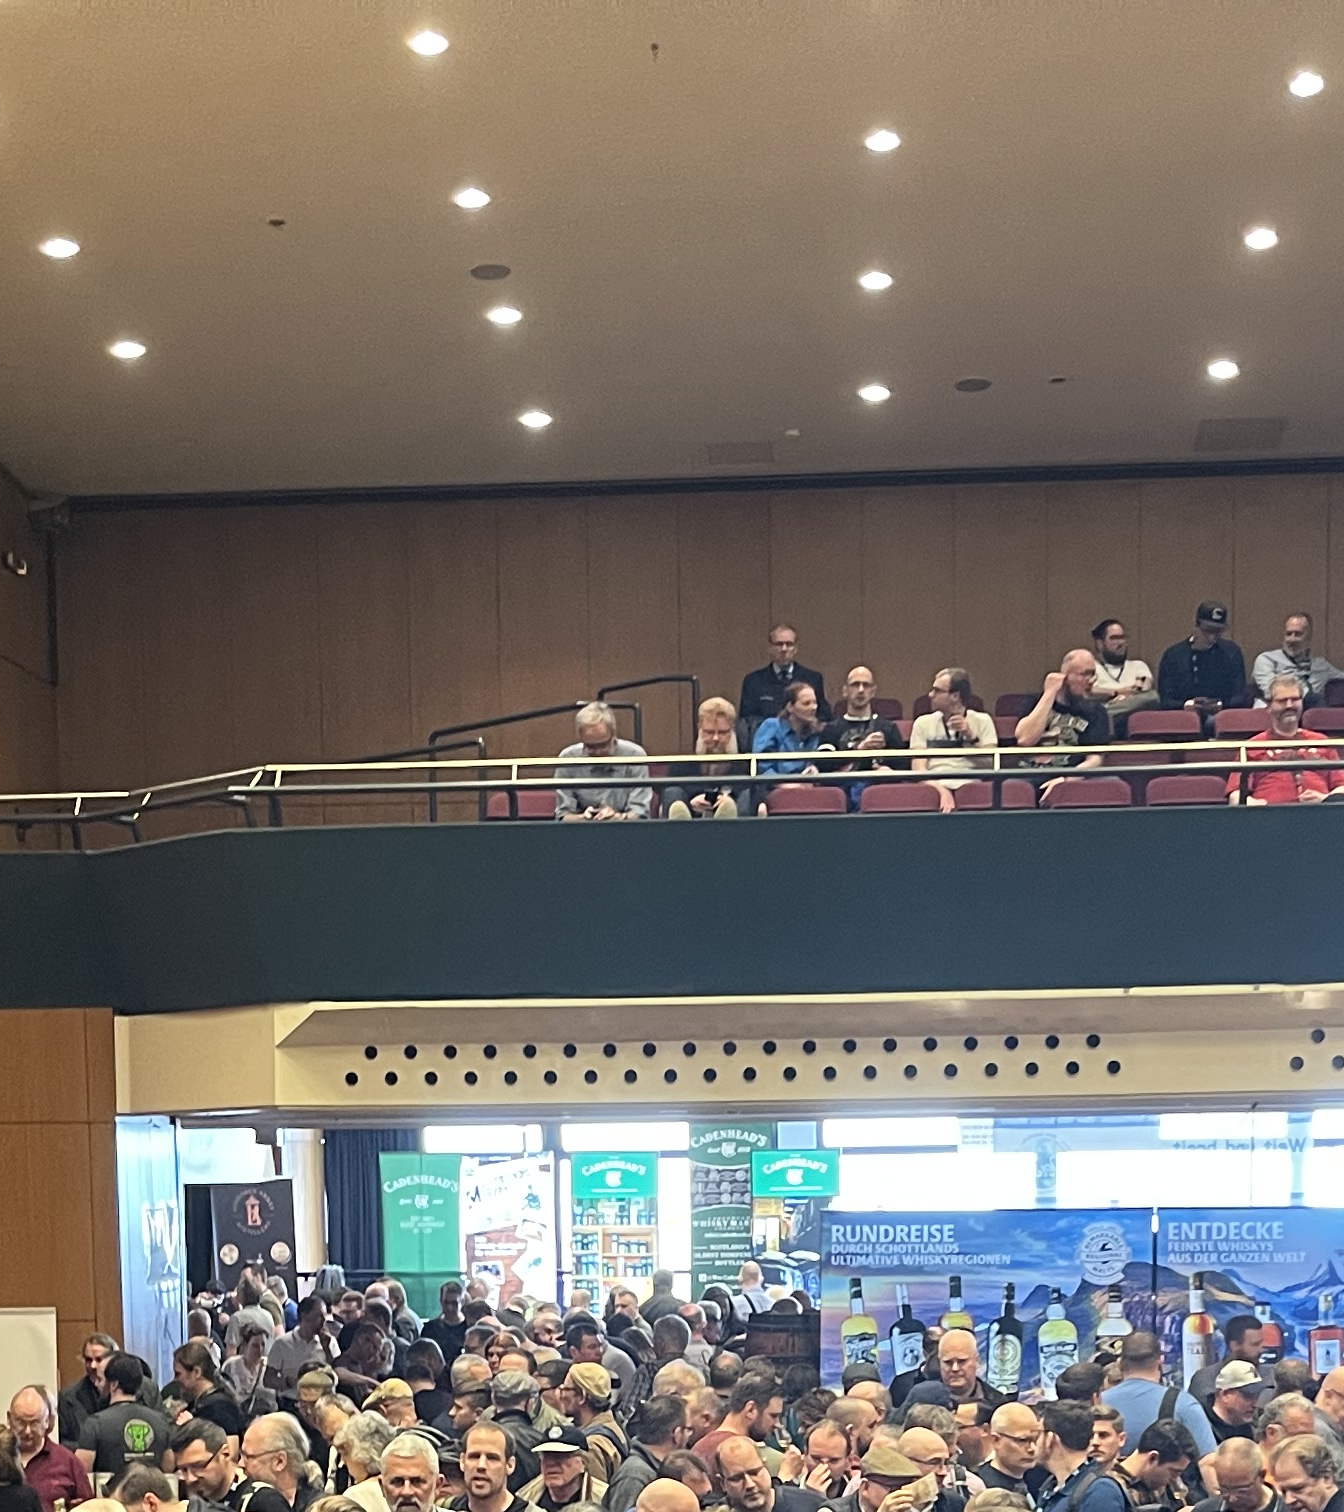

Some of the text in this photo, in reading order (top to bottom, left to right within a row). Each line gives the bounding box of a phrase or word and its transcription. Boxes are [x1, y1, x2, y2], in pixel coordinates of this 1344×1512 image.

[691, 1128, 768, 1148] CADENHEAD'S
[831, 1224, 954, 1243] RUNDREISE
[1167, 1222, 1284, 1240] ENTDECKE
[831, 1242, 959, 1254] DURCH SCHOTTLANDS
[1167, 1241, 1273, 1252] FEINSTE WHISKYS
[831, 1254, 1011, 1266] ULTIMATIVE WHISKYREGIONEN
[1167, 1252, 1305, 1264] AUS DER GANZEN WELT
